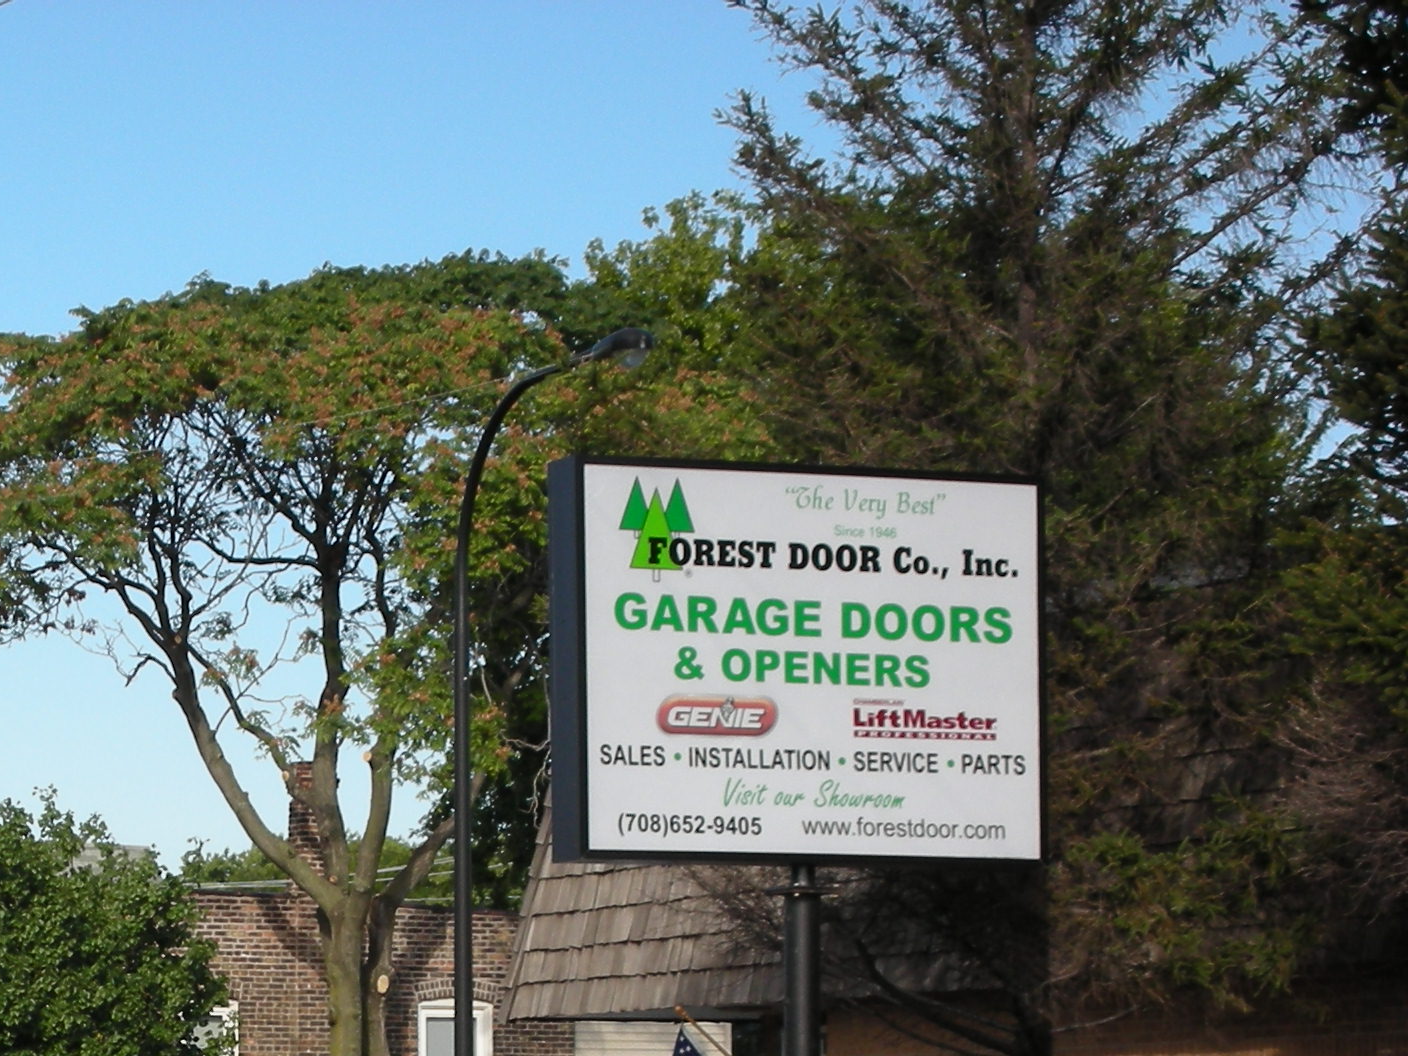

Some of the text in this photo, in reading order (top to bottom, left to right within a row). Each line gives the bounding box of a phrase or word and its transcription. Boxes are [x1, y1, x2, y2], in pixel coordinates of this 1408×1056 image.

[843, 488, 887, 520] Very
[833, 524, 897, 539] Since 1946
[648, 536, 1019, 580] FOREST DOOR Co., Inc.
[614, 591, 1013, 645] GARAGE DOORS
[673, 646, 931, 689] & OPENERS
[667, 705, 765, 729] GENIE
[853, 708, 997, 730] LiftMaster
[855, 730, 995, 740] PROFESSIONAL
[600, 744, 1026, 776] SALES INSTALLATION SERVICE PARTS
[722, 777, 907, 809] Visit our Showroom
[618, 812, 1006, 840] (708)652-9405 www.forestdoor.com
